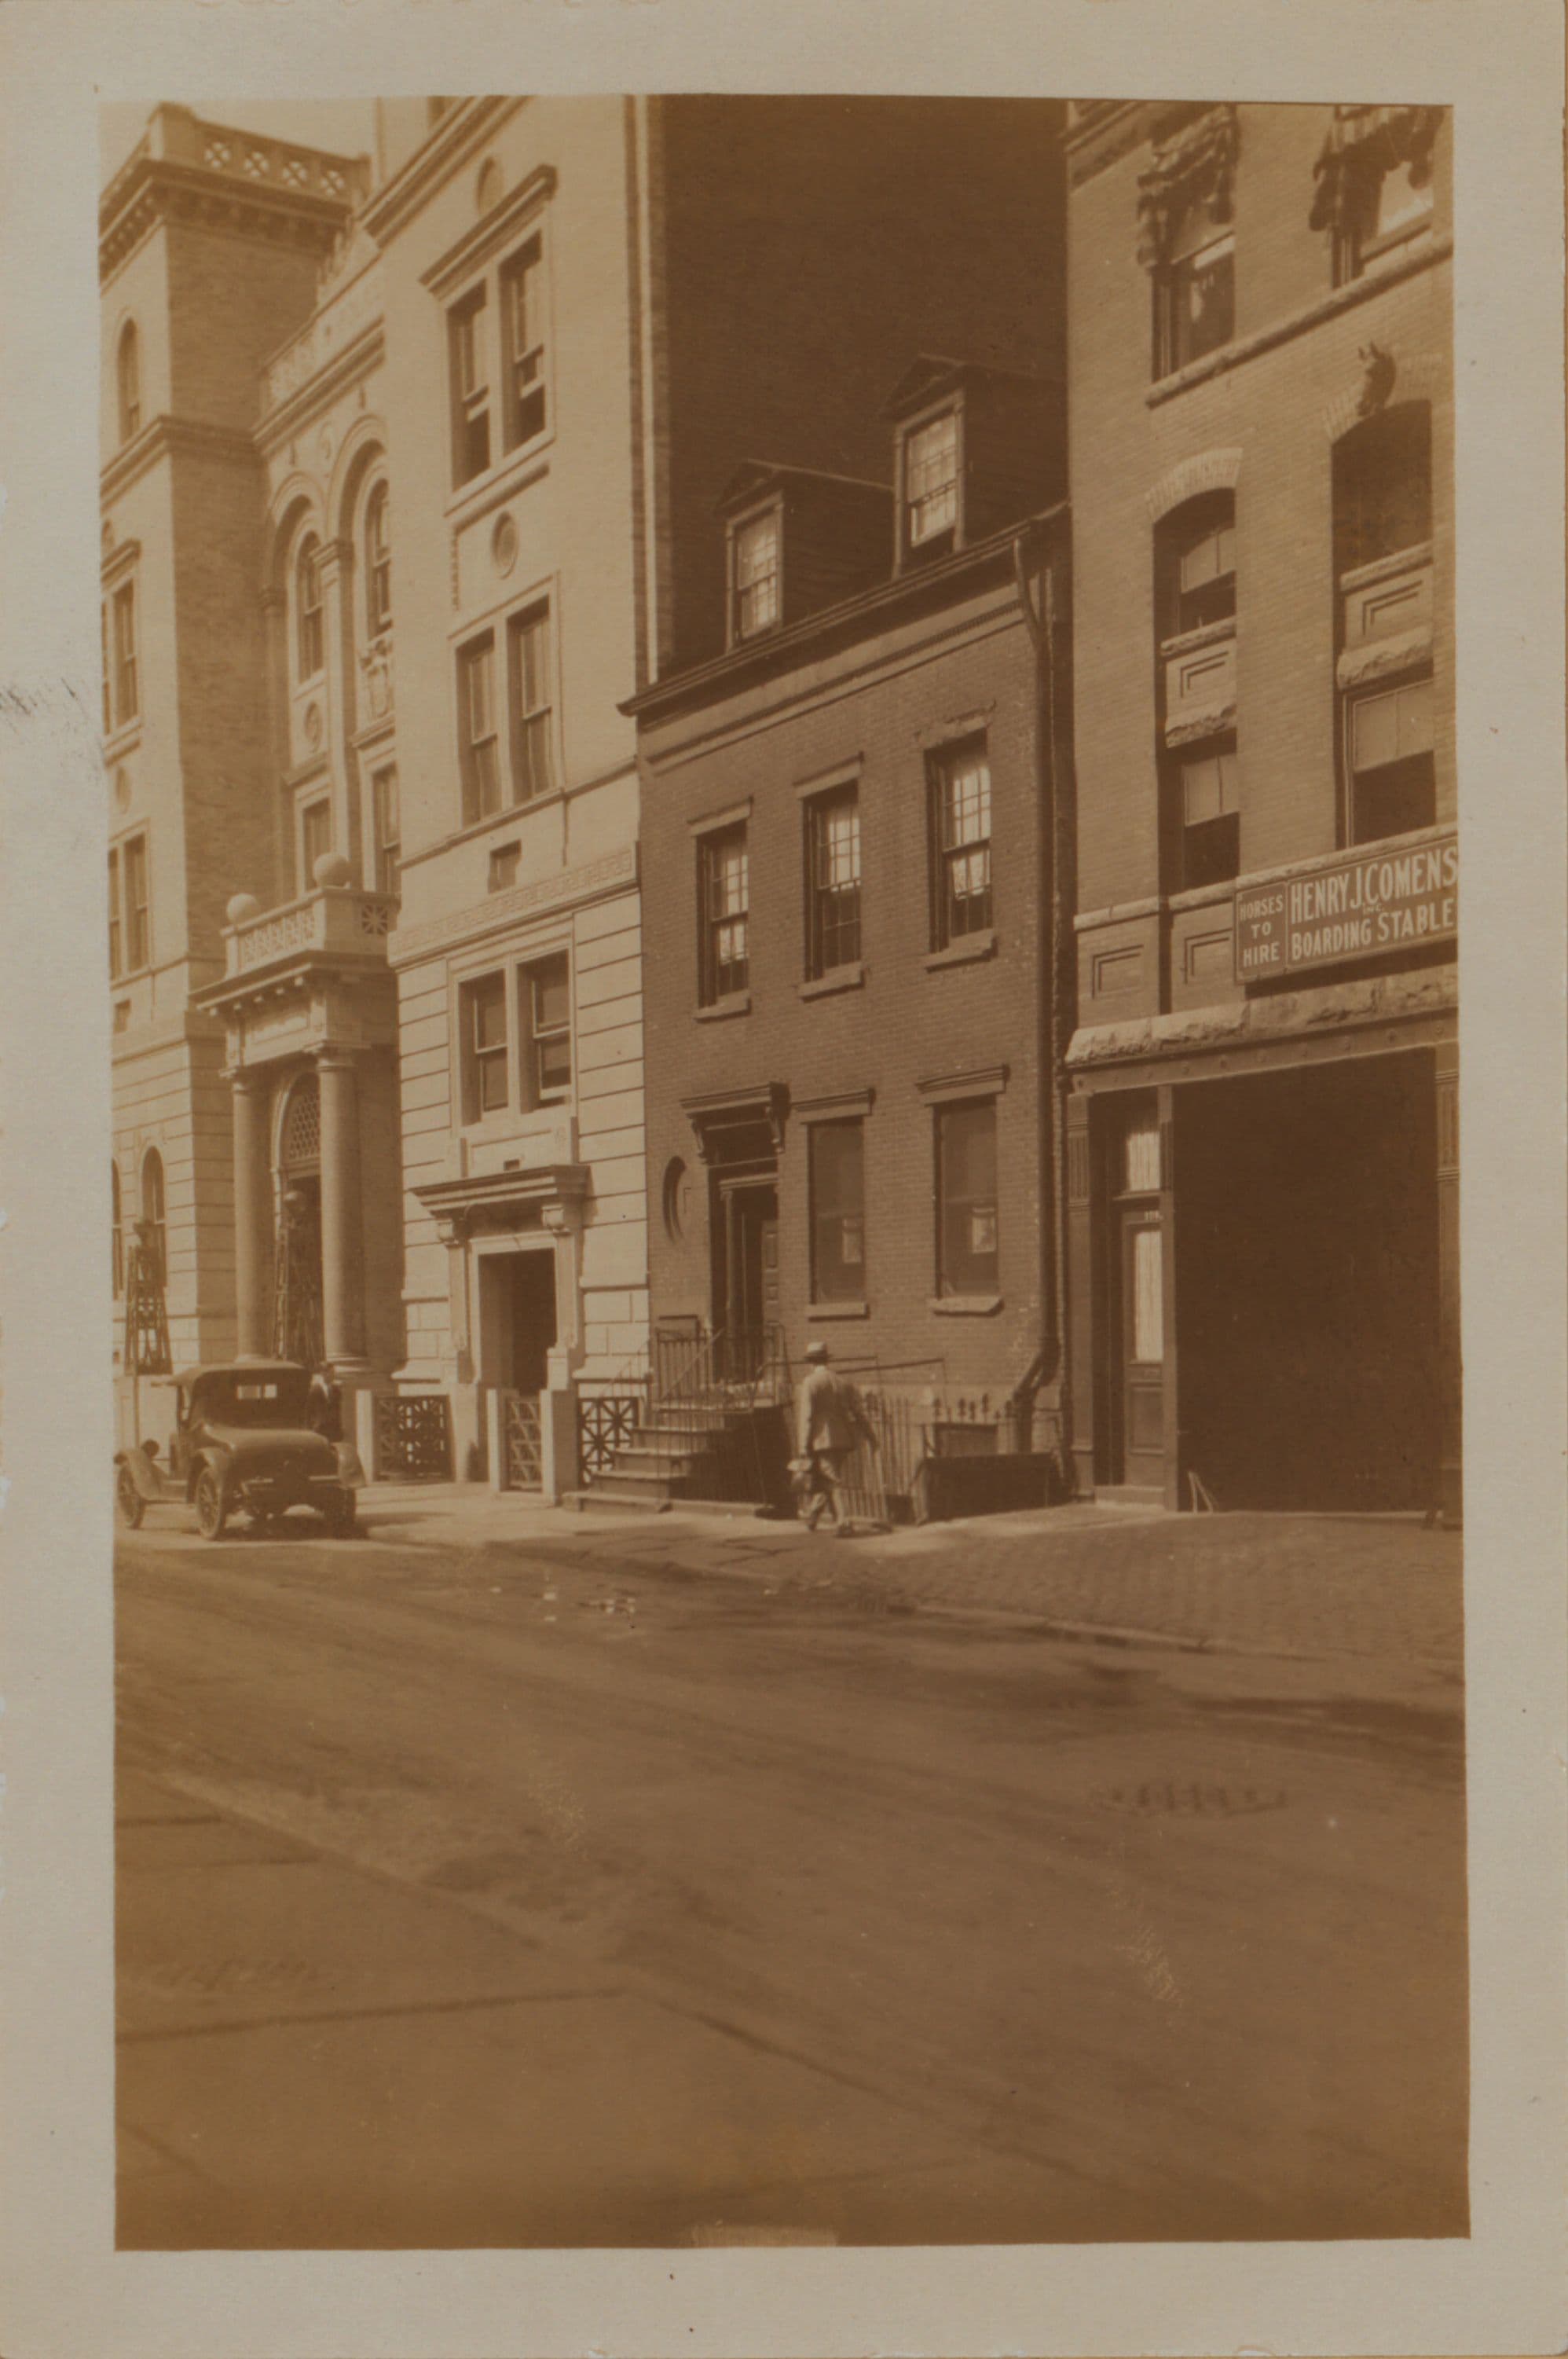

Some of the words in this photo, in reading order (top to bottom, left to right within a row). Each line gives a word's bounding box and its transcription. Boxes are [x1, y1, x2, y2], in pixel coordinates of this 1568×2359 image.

[1240, 895, 1283, 920] HORSES
[1291, 873, 1350, 923] HENRY
[1251, 922, 1271, 939] TO
[1291, 919, 1372, 959] BOARDING
[1377, 898, 1453, 942] STABLE
[1244, 942, 1280, 967] HIRE
